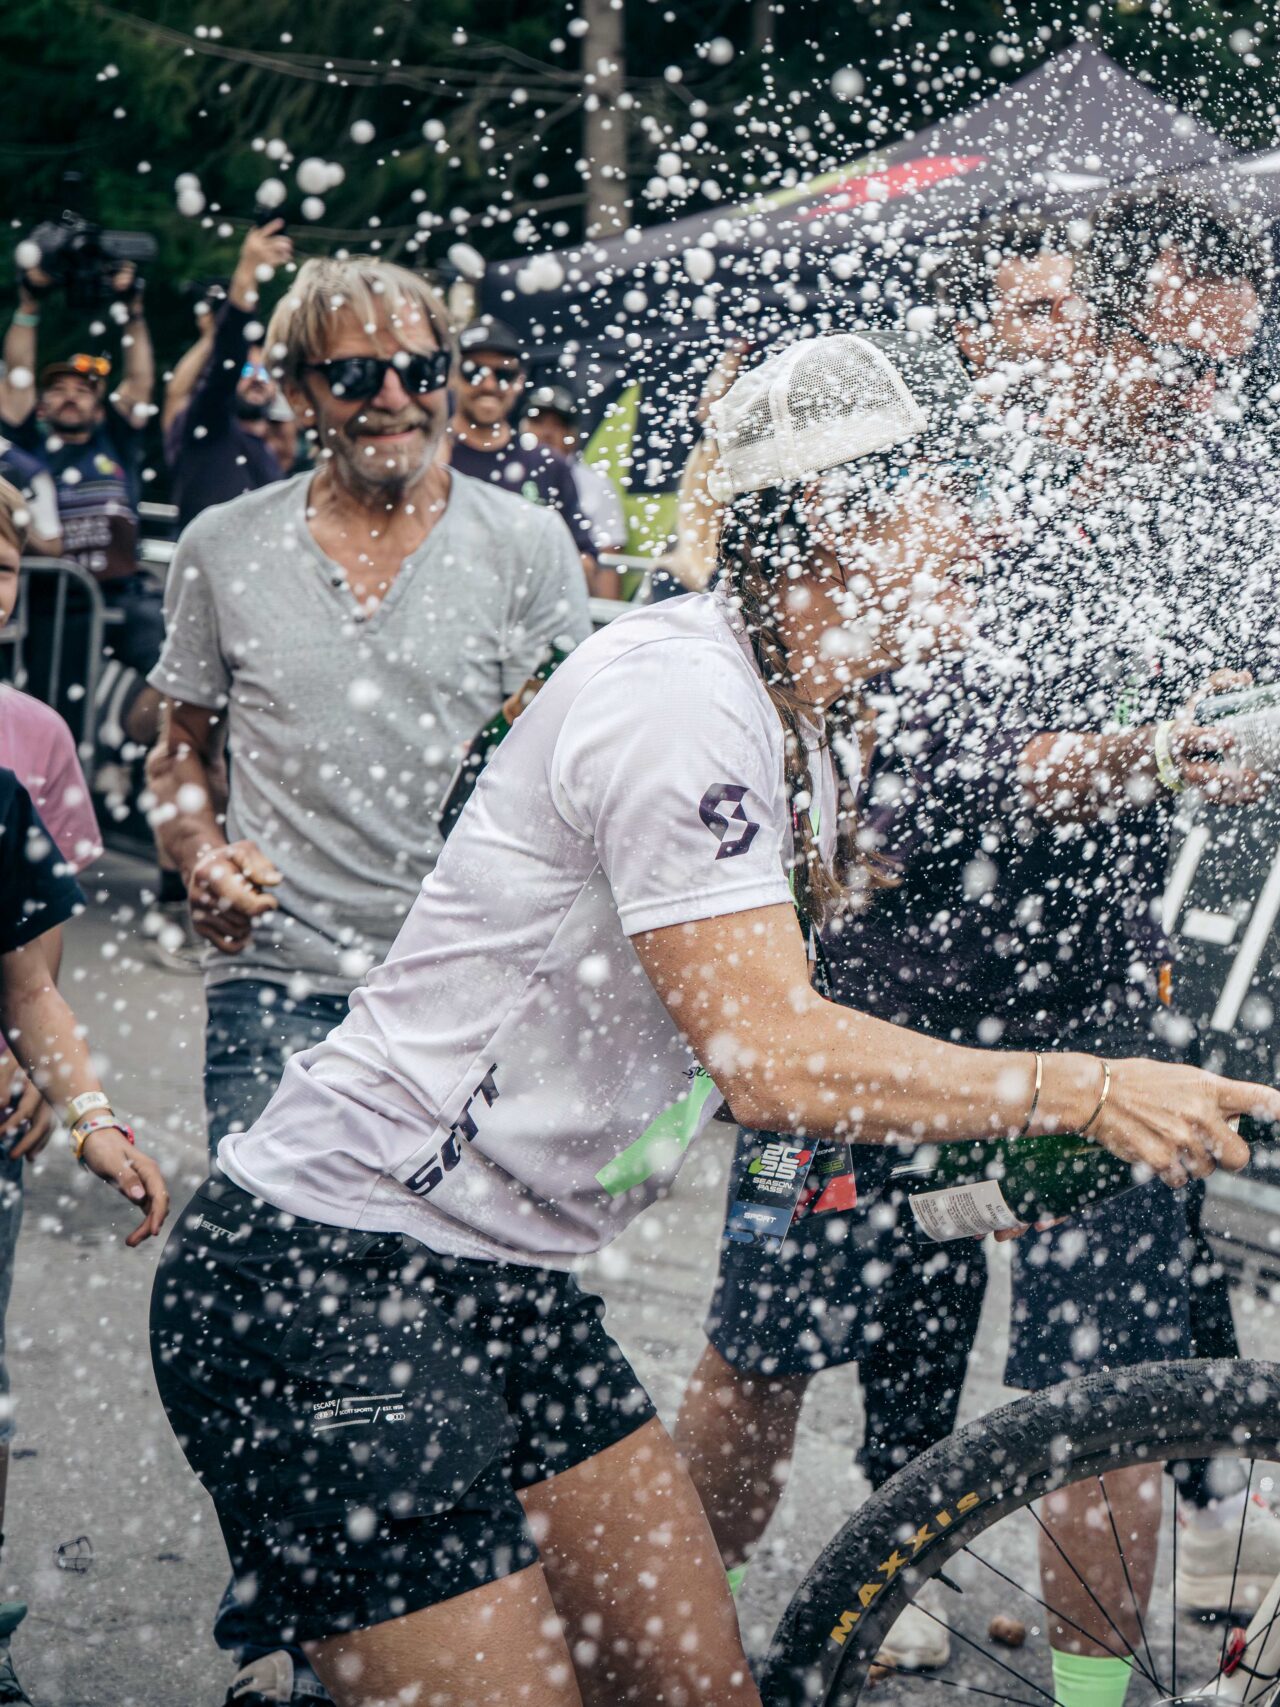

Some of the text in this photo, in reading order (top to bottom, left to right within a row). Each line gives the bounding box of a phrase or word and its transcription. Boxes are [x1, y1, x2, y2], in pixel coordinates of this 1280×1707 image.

[404, 1062, 500, 1197] SCTT
[757, 1184, 784, 1194] PASS
[743, 1212, 777, 1224] SPORT
[313, 1400, 336, 1411] ESCAPE
[830, 1492, 980, 1647] MAXXIS
